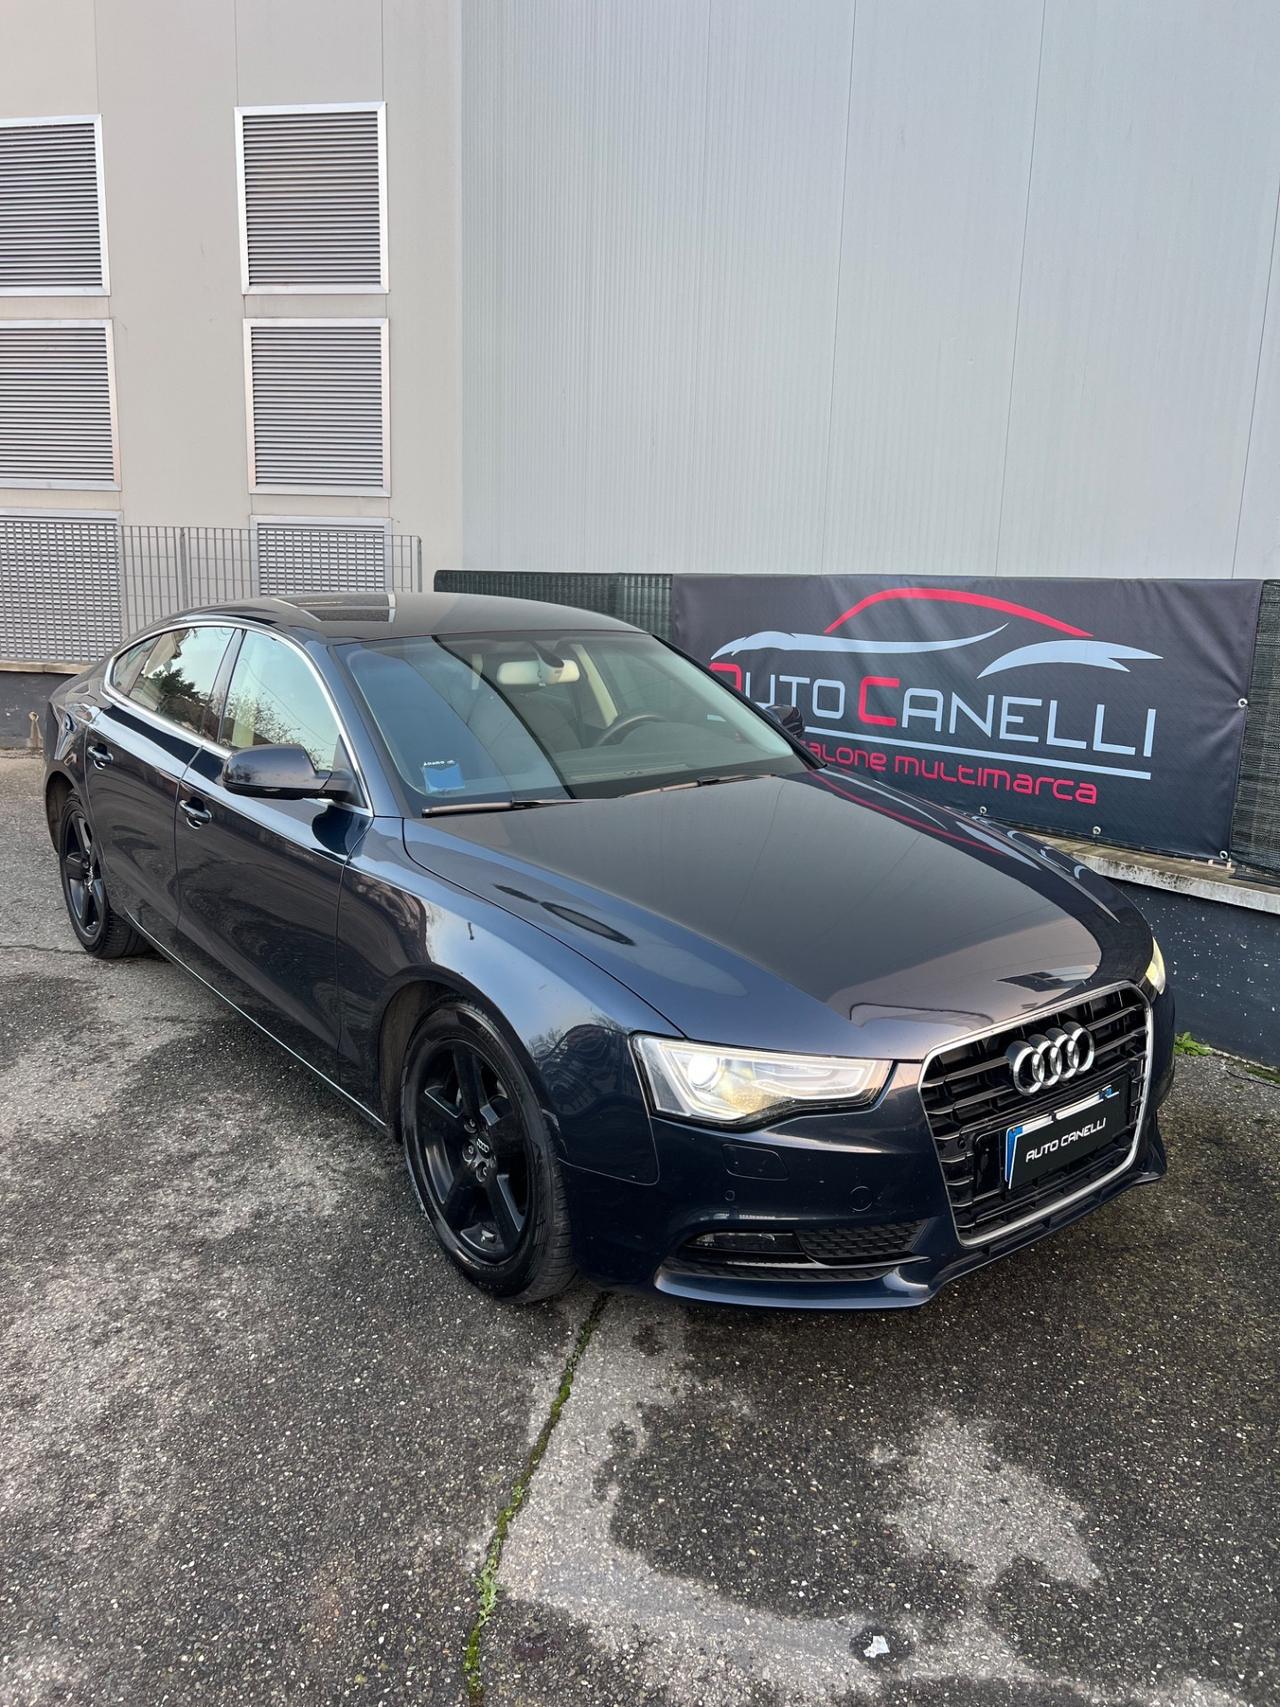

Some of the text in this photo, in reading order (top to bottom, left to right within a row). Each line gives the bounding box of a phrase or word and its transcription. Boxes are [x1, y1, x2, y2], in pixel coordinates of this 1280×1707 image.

[858, 675, 1156, 757] CANELLI
[800, 741, 1097, 805] alone multimarca
